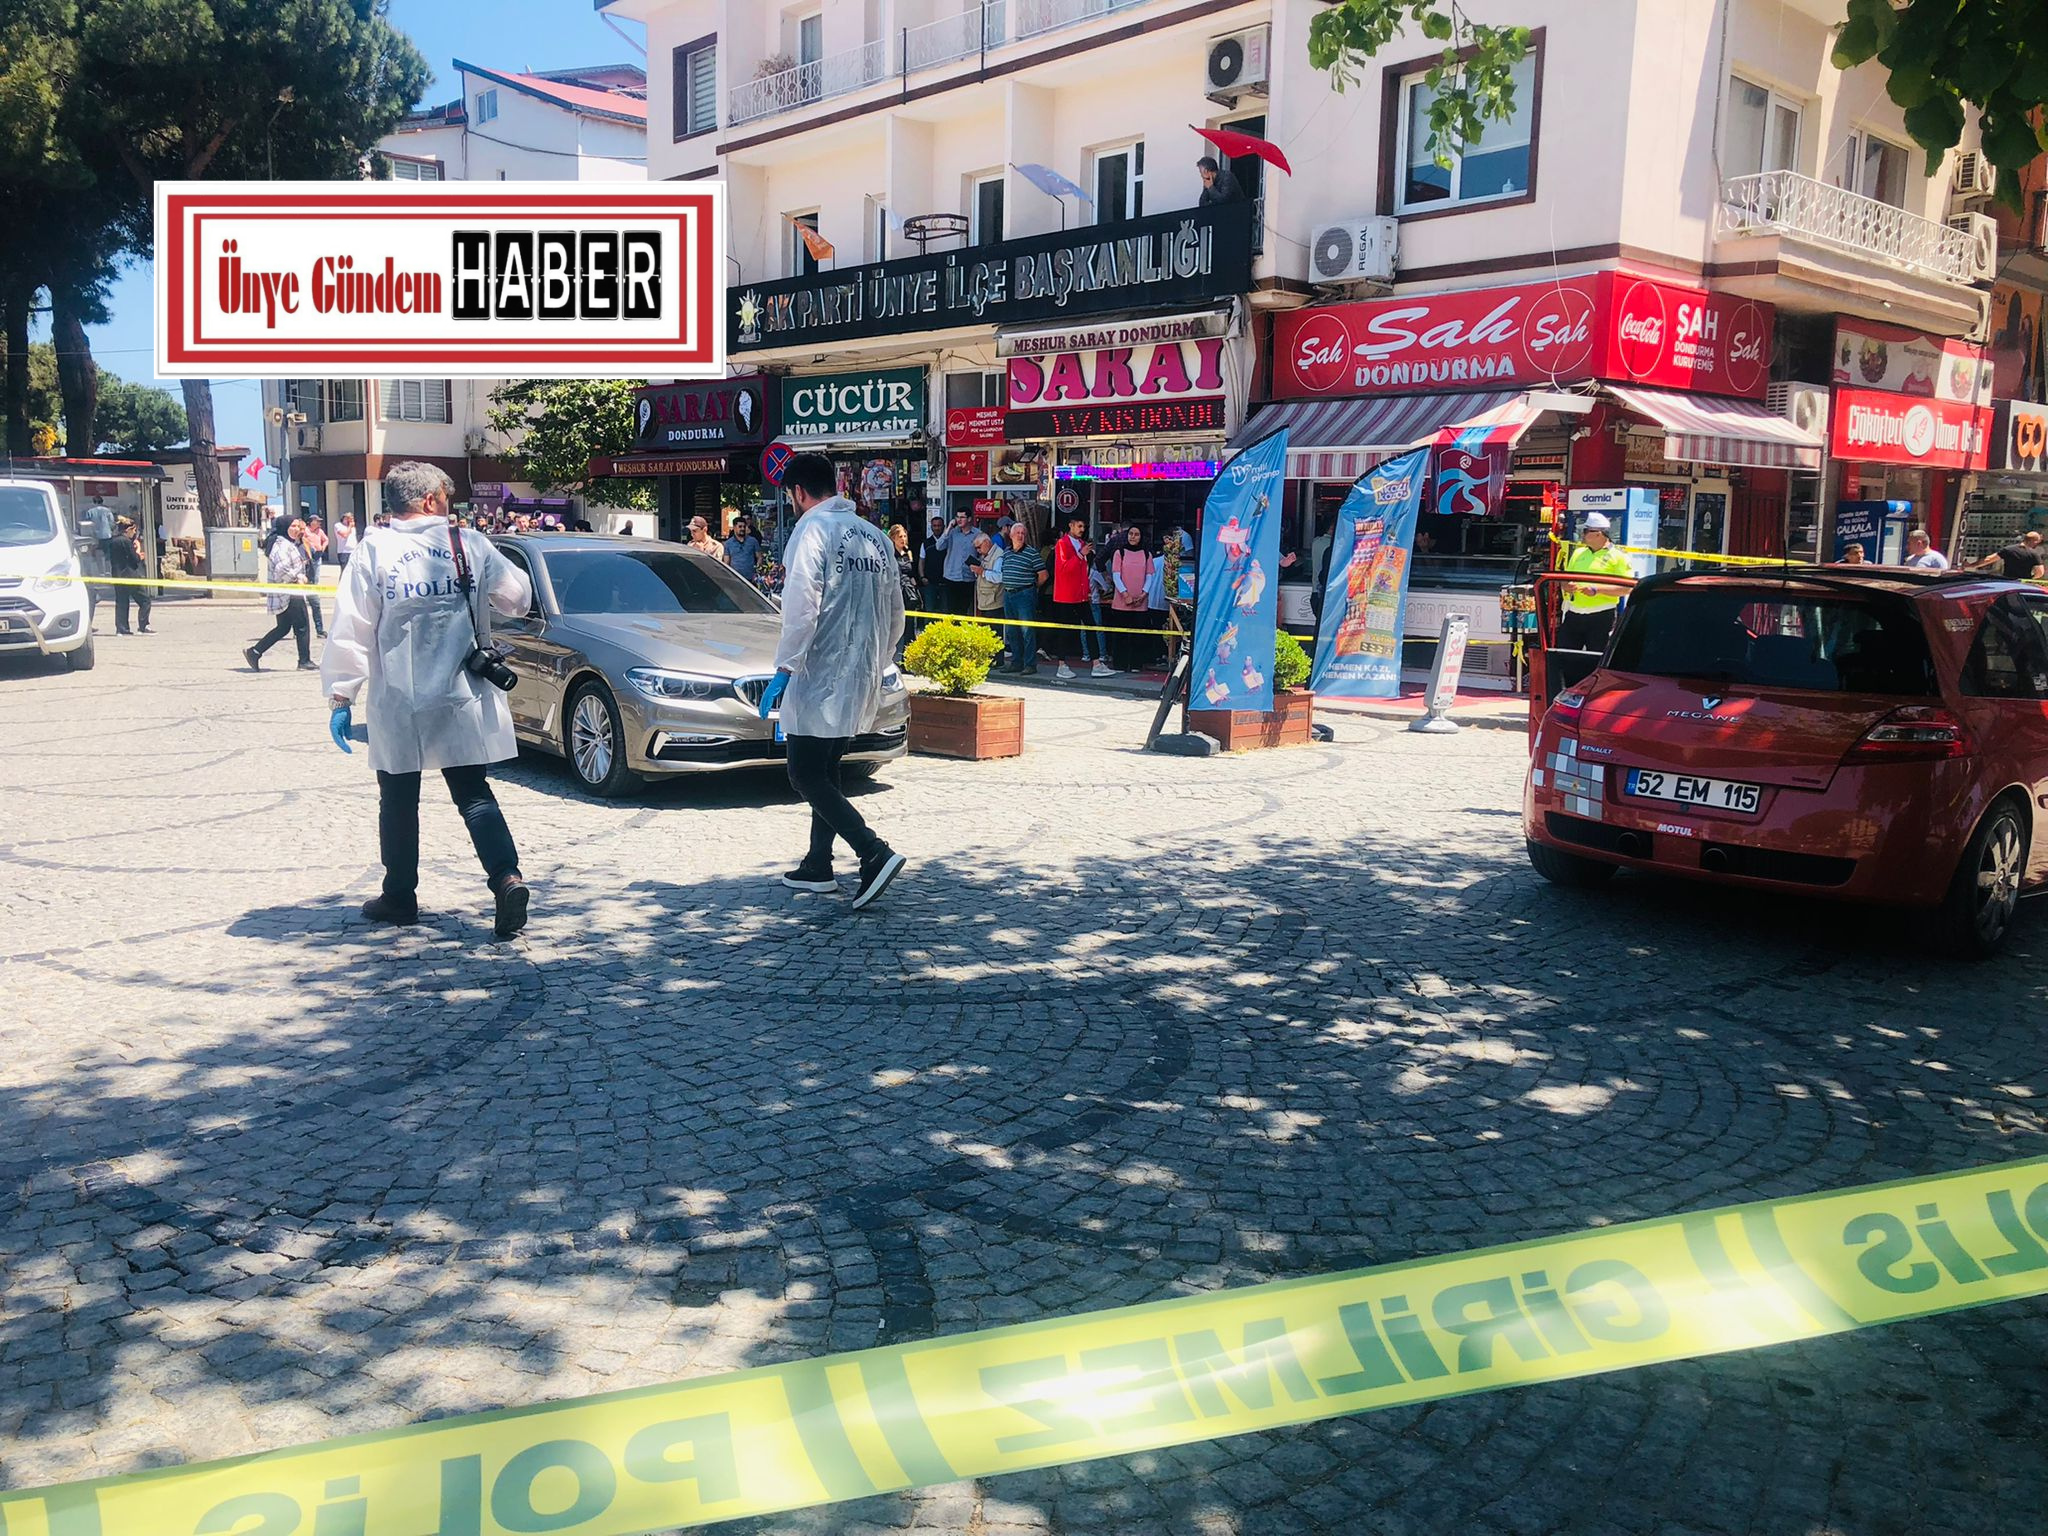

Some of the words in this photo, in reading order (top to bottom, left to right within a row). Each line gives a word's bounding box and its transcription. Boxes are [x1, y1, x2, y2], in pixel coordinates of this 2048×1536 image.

[1358, 226, 1368, 271] REGAL
[764, 292, 798, 333] AK
[800, 271, 863, 328] PARTİ
[869, 268, 937, 319] ÜNYE
[946, 254, 1007, 317] İLÇE
[1014, 219, 1214, 307] BAŞKANLIĞI
[1354, 296, 1521, 361] Şah
[1530, 309, 1591, 352] Şah
[1677, 303, 1719, 341] ŞAH
[1069, 329, 1117, 349] SARAY
[1674, 340, 1715, 358] DONDURMA
[1730, 332, 1761, 362] Şah
[1297, 334, 1345, 370] Şah
[1354, 352, 1516, 387] DONDURMA
[1673, 354, 1715, 374] KURUYEMİŞ
[655, 390, 733, 425] SARAY
[792, 378, 914, 417] CÜCÜR
[668, 427, 725, 441] DONDURMA
[785, 421, 829, 436] KİTAP
[1935, 412, 1959, 451] Ömer
[648, 461, 674, 473] SARAY
[675, 459, 721, 473] DONDURMA
[166, 495, 185, 503] ÜNYE
[1582, 493, 1612, 503] damla
[1634, 508, 1653, 518] damla
[1836, 522, 1872, 536] ÇALKALA
[835, 541, 846, 574] OLAY
[847, 555, 881, 574] POLİS
[385, 564, 400, 600] OLAY
[403, 574, 464, 598] POLİS
[1322, 671, 1357, 680] HEMEN
[1328, 662, 1362, 672] HEMEN
[1666, 709, 1739, 724] MEGANE
[1581, 744, 1614, 755] RENAULT
[1637, 771, 1665, 796] 52
[1673, 777, 1711, 802] EM
[1724, 783, 1759, 811] 115
[1656, 823, 1693, 836] MOTUL
